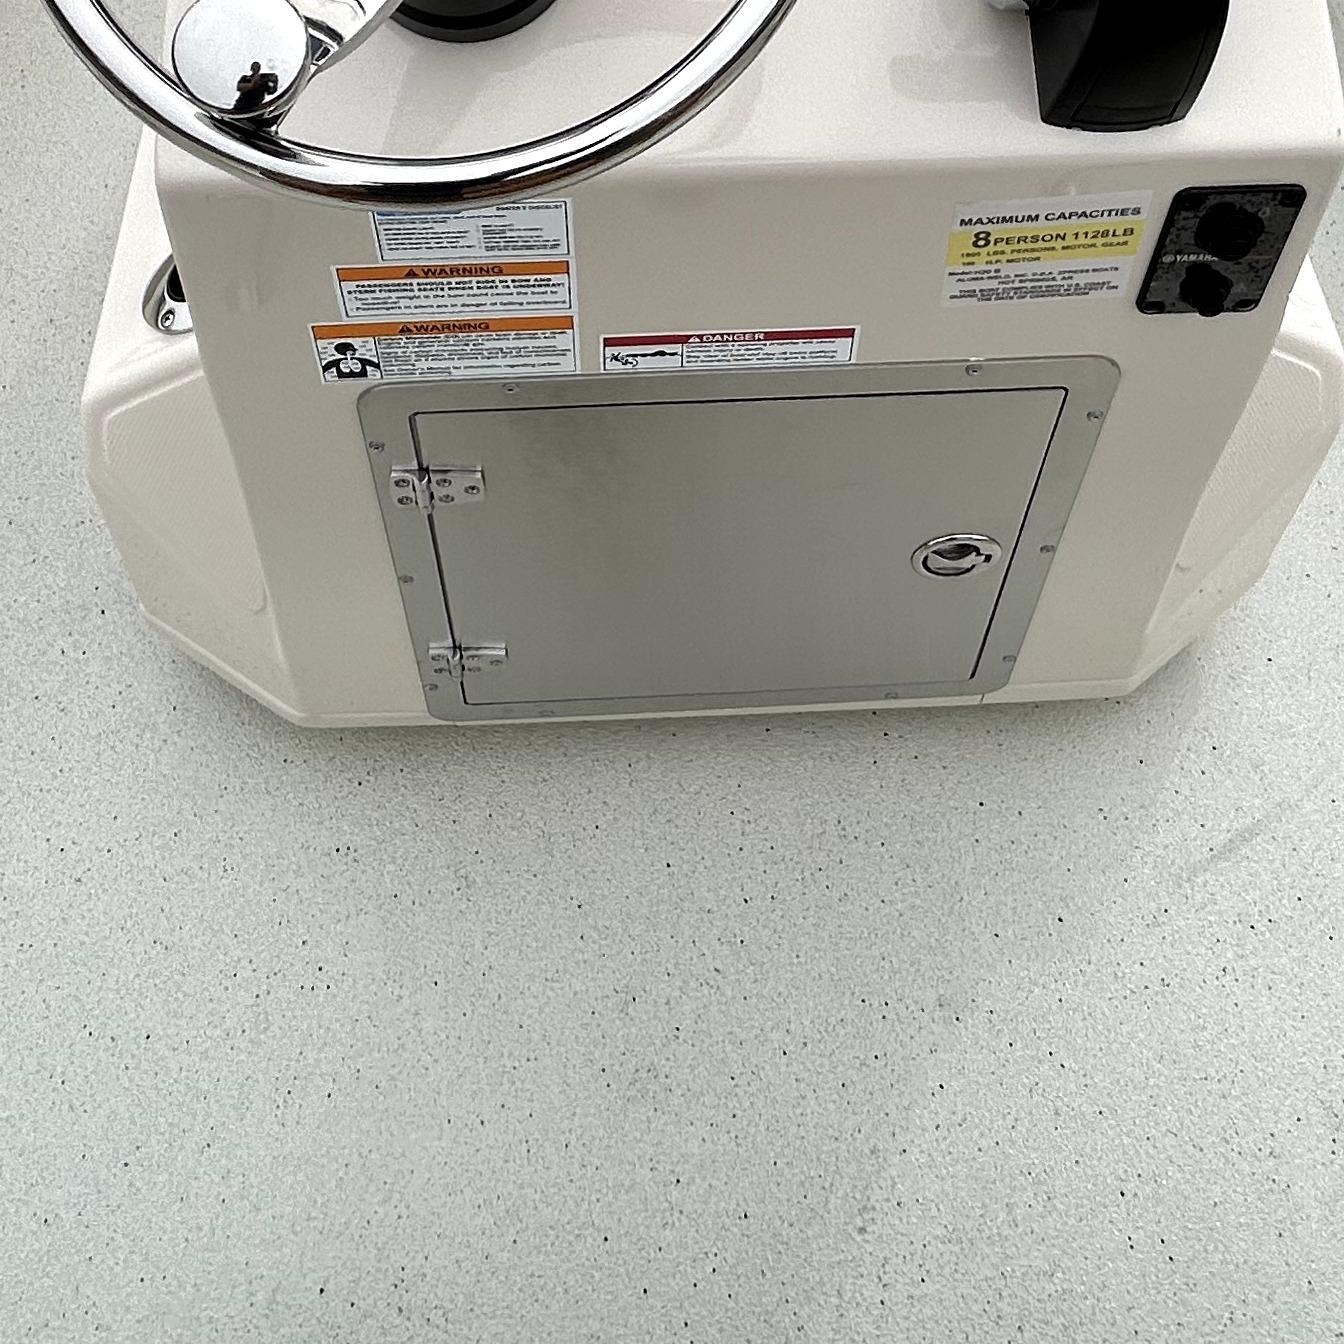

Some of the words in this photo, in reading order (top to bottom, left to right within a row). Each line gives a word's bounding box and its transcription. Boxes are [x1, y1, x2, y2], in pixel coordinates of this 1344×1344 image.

[959, 214, 1040, 227] MAXIMUM
[1044, 207, 1142, 221] CAPACITIES
[972, 230, 992, 248] 8
[993, 231, 1066, 246] PERSON
[420, 265, 504, 276] WARNING
[413, 321, 490, 333] WARNING
[702, 333, 765, 342] DANGER
